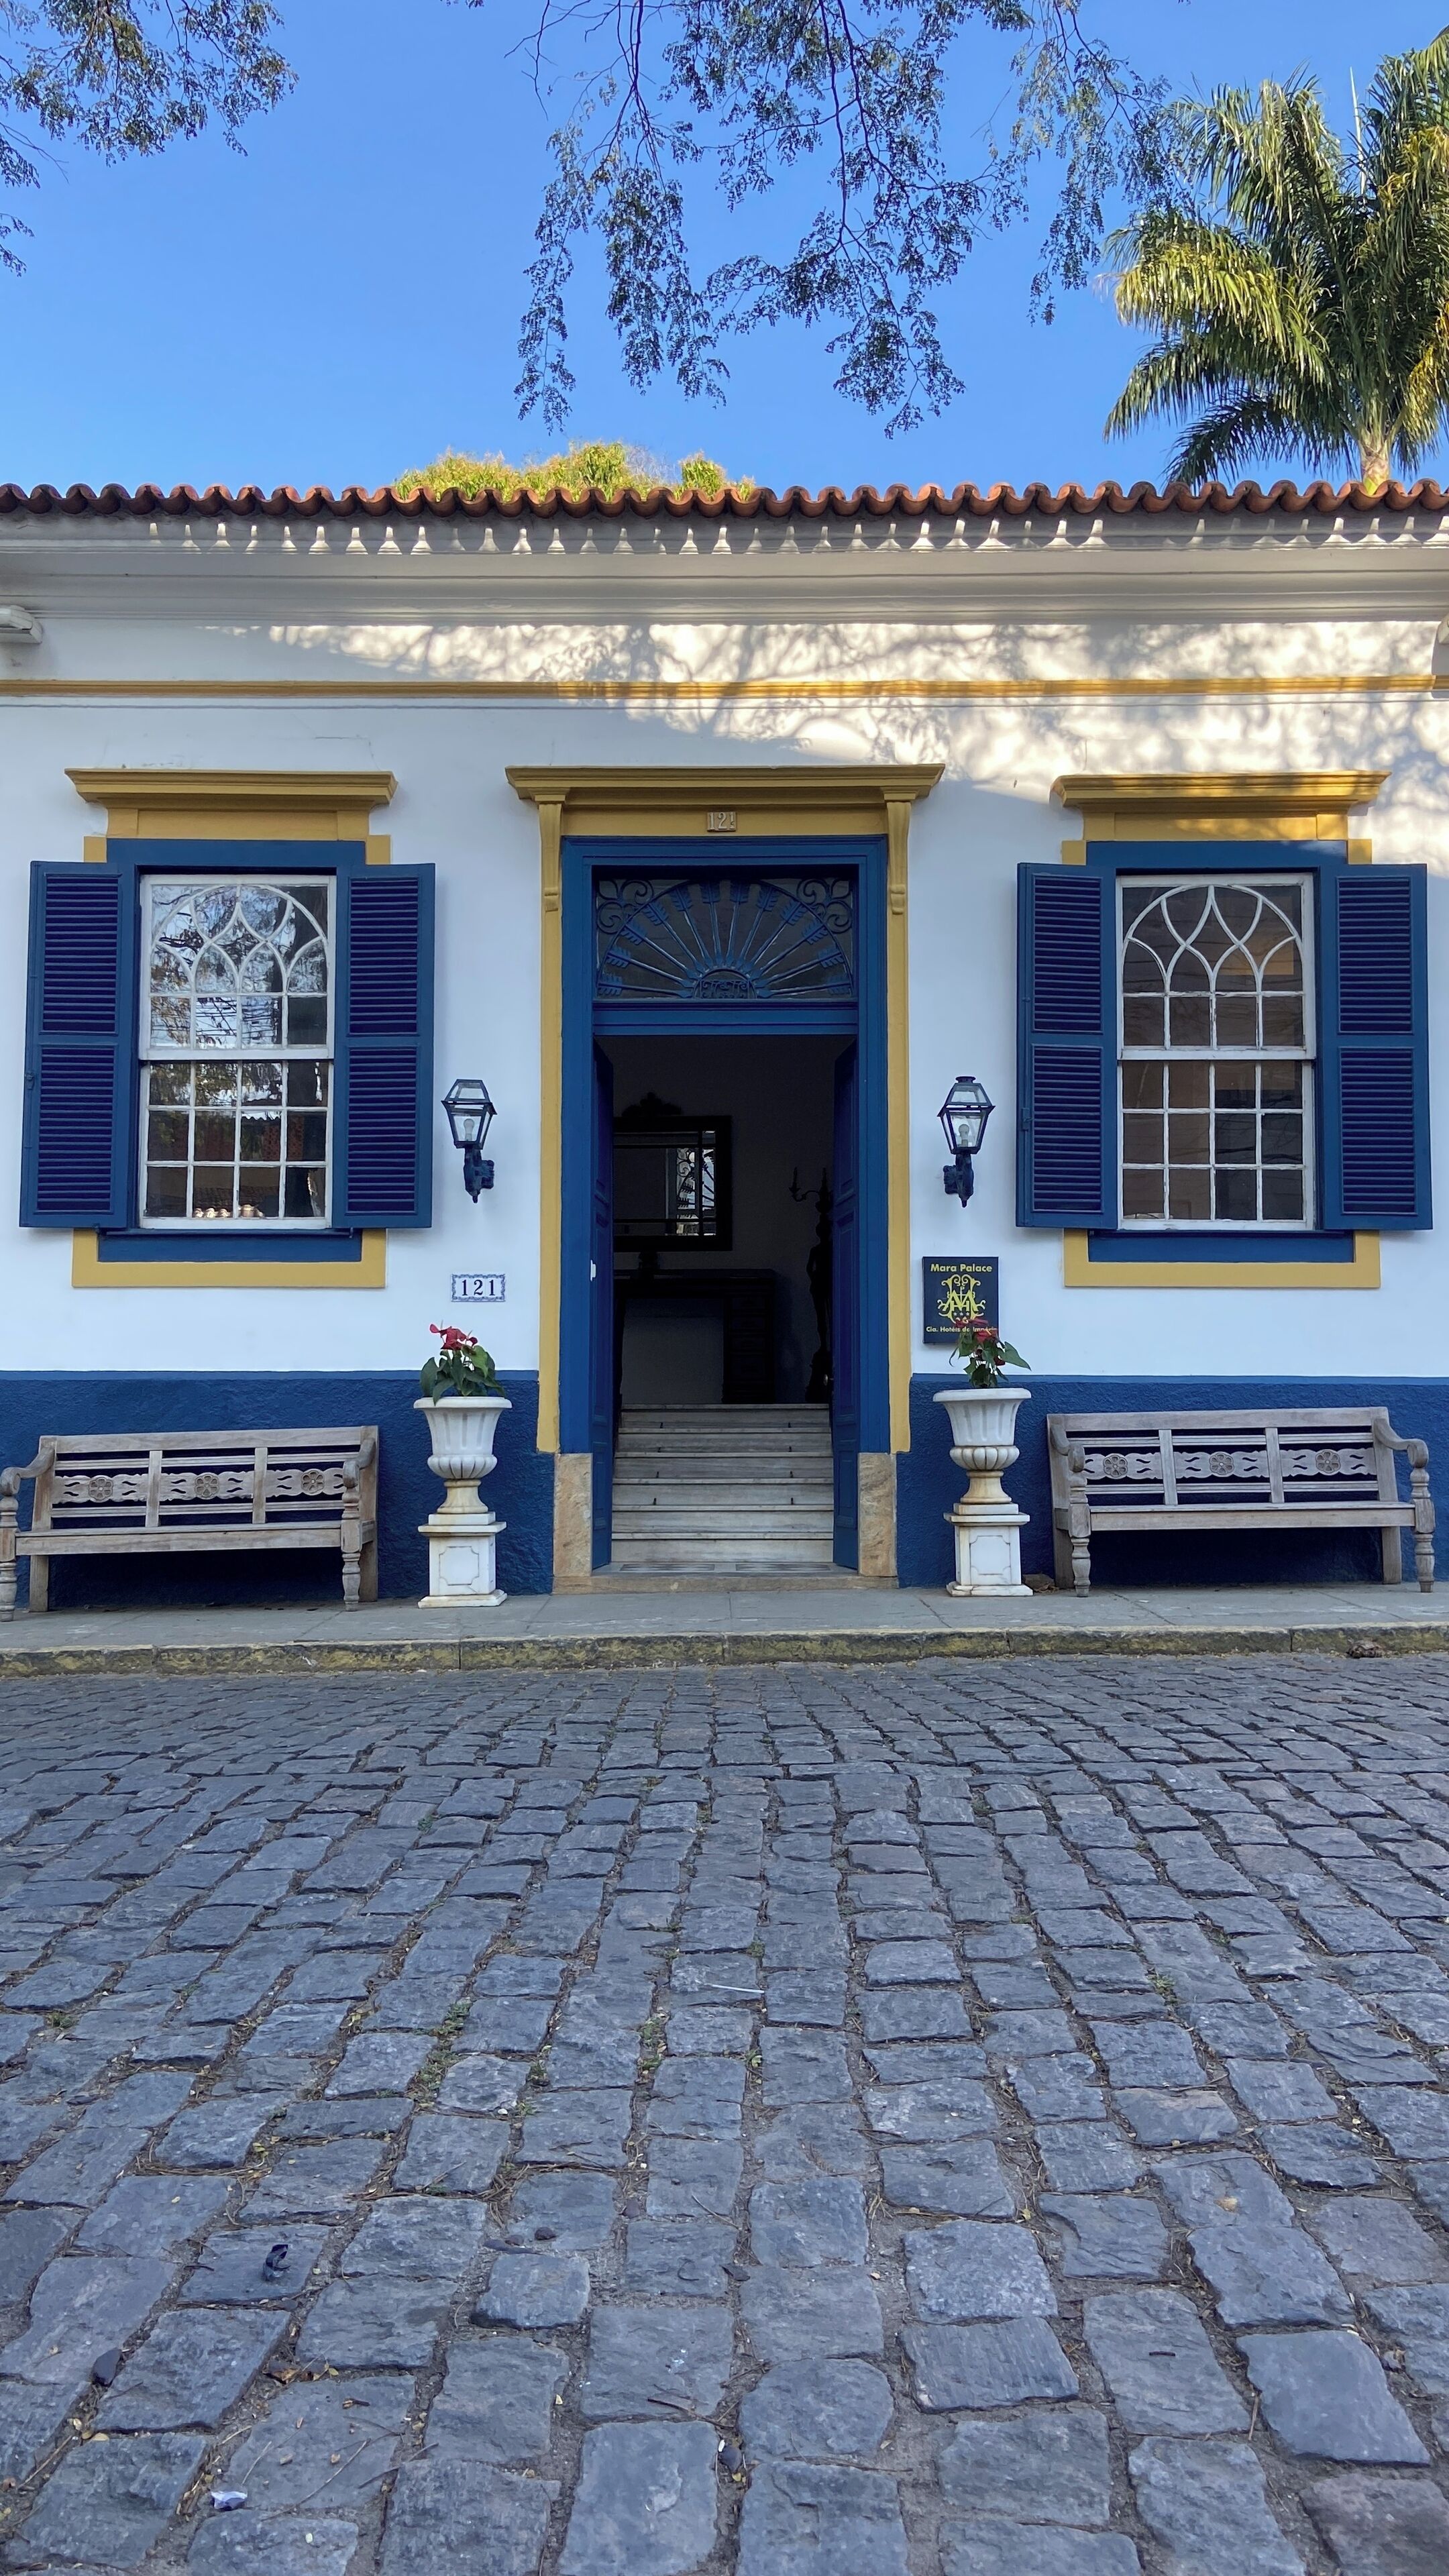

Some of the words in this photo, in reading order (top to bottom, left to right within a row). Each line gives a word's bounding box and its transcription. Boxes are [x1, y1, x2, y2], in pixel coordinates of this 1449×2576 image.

[709, 812, 735, 830] 121
[930, 1264, 957, 1272] Mara
[960, 1264, 992, 1272] Palace
[462, 1279, 495, 1296] 121
